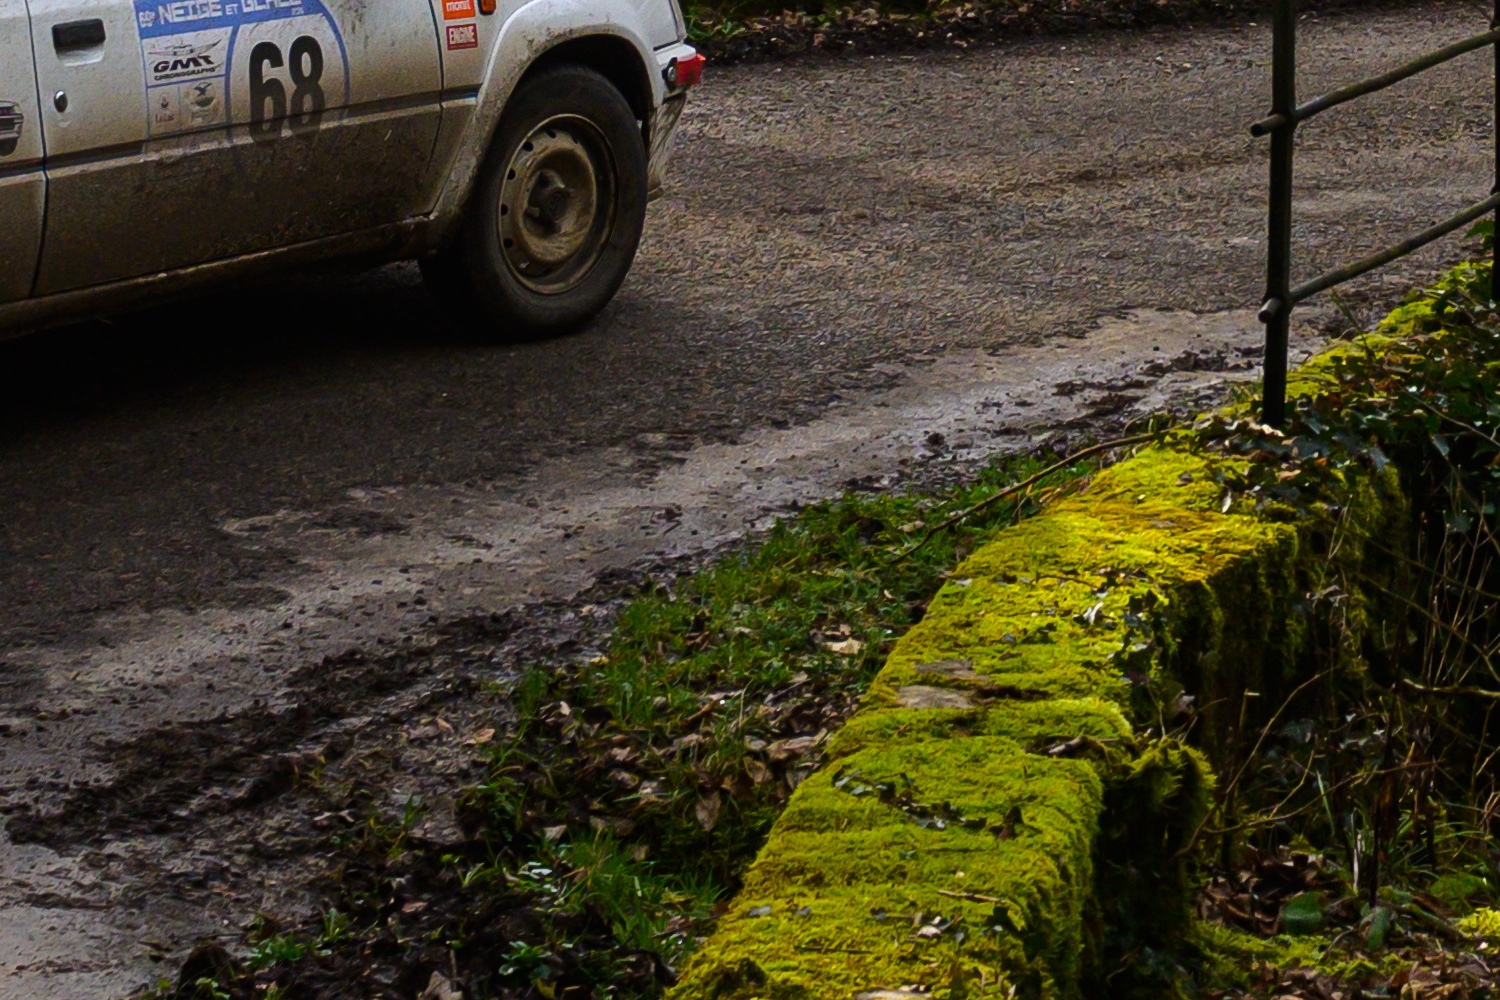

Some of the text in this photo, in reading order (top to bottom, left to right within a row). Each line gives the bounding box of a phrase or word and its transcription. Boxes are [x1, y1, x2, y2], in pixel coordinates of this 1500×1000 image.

[225, 3, 238, 16] ET
[153, 54, 215, 73] GMT
[248, 34, 326, 143] 68
